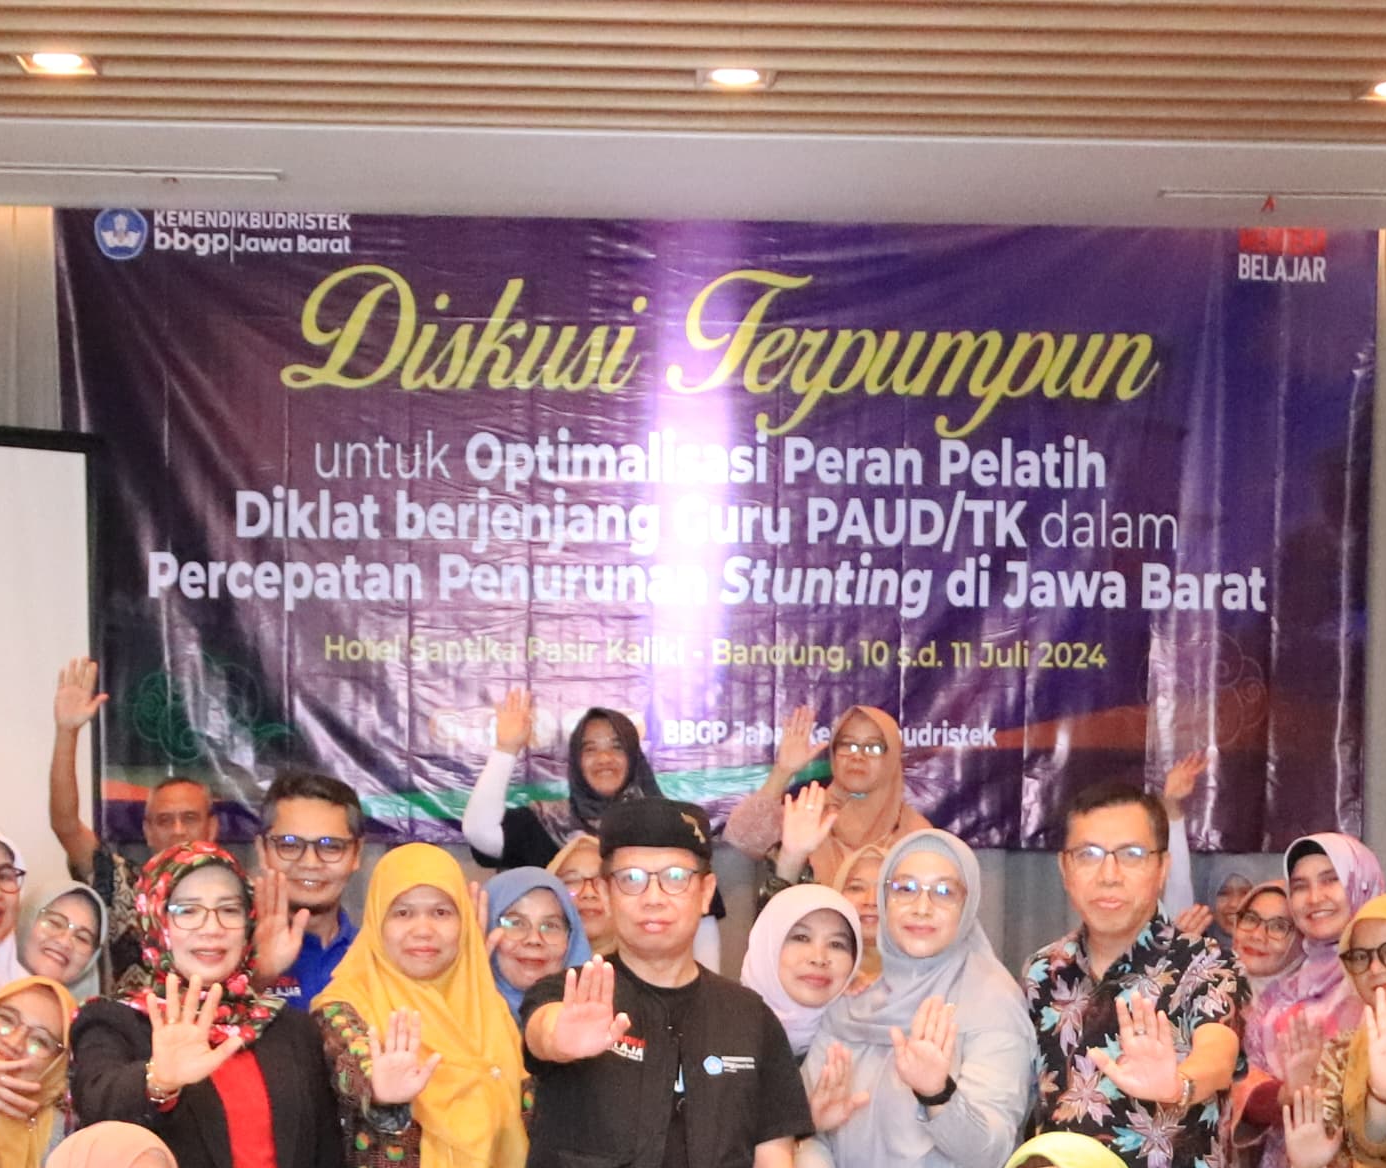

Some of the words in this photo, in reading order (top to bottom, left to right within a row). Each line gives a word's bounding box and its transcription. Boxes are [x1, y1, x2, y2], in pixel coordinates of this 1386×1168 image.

[154, 210, 351, 231] KEMENDIKBUDRISTEK
[154, 228, 229, 256] bbgp
[233, 233, 293, 253] Jawa
[297, 234, 351, 254] Barat
[1238, 253, 1327, 283] BELAJAR
[280, 264, 647, 393] Diskusi
[667, 269, 1159, 438] Terpumpun
[314, 430, 451, 480] untuk
[466, 427, 766, 490] Optimalisasi
[784, 436, 922, 486] Peran
[939, 435, 1107, 488] Pelatih
[235, 485, 381, 540] Diklat
[396, 487, 661, 554] berjenjang
[674, 497, 790, 546] Guru
[807, 491, 1027, 553] PAUD/TK
[1040, 500, 1178, 549] dalam
[148, 550, 422, 611] Percepatan
[438, 553, 709, 600] Penurunan
[720, 552, 932, 618] Stunting
[945, 551, 991, 607] di
[1003, 561, 1126, 610] Jawa
[1141, 562, 1267, 612] Barat
[324, 634, 401, 662] Hotel
[409, 634, 518, 664] Santika
[528, 635, 599, 664] Pasir
[713, 639, 852, 673] Bandung,
[860, 641, 890, 667] 10
[897, 640, 943, 668] s.d.
[951, 642, 972, 668] 11
[979, 641, 1030, 670] Juli
[1038, 642, 1107, 670] 2024
[663, 719, 728, 746] BBGP
[732, 720, 784, 747] Jaba
